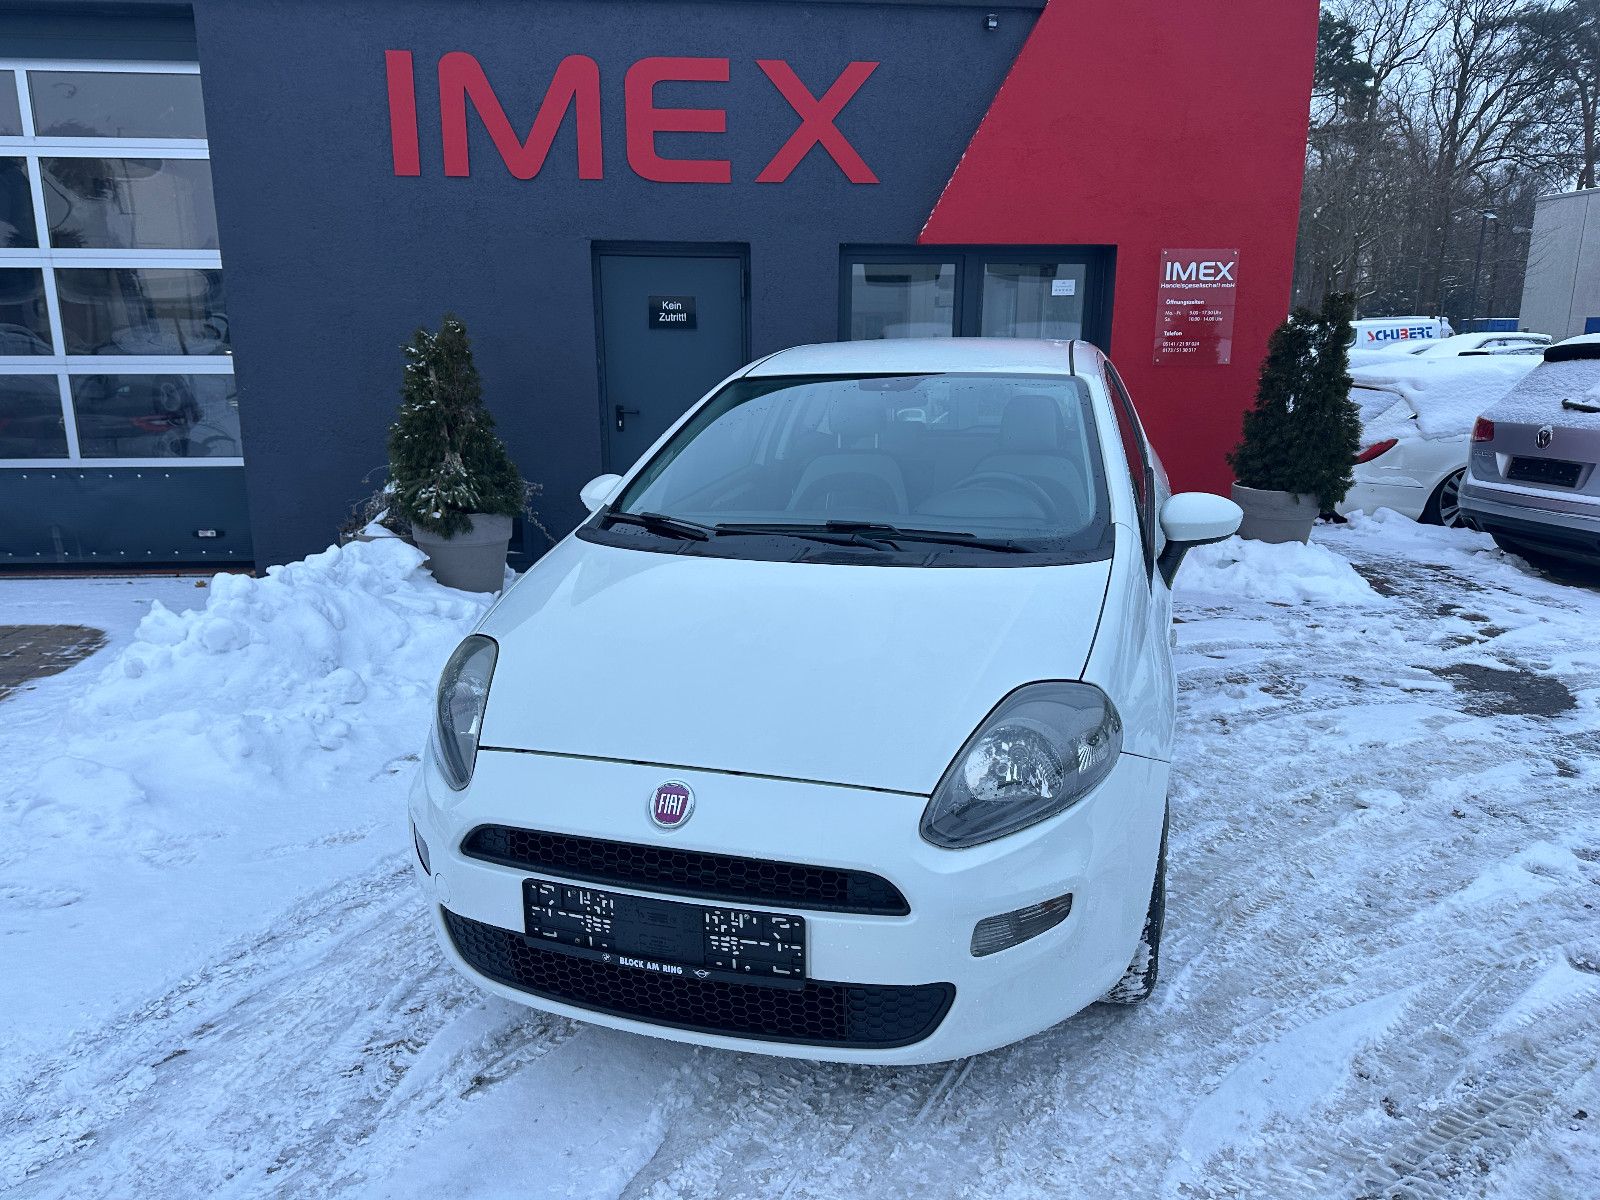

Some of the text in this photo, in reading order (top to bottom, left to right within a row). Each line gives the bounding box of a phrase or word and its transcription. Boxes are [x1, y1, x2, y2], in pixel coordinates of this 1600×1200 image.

[385, 50, 881, 184] IMEX
[1165, 261, 1235, 281] IMEX
[662, 301, 682, 310] Kein
[659, 312, 687, 321] Zutritt!
[1367, 326, 1433, 342] SCHUBERT
[657, 793, 686, 816] FIAT
[619, 956, 683, 975] BLOCK AM RING
